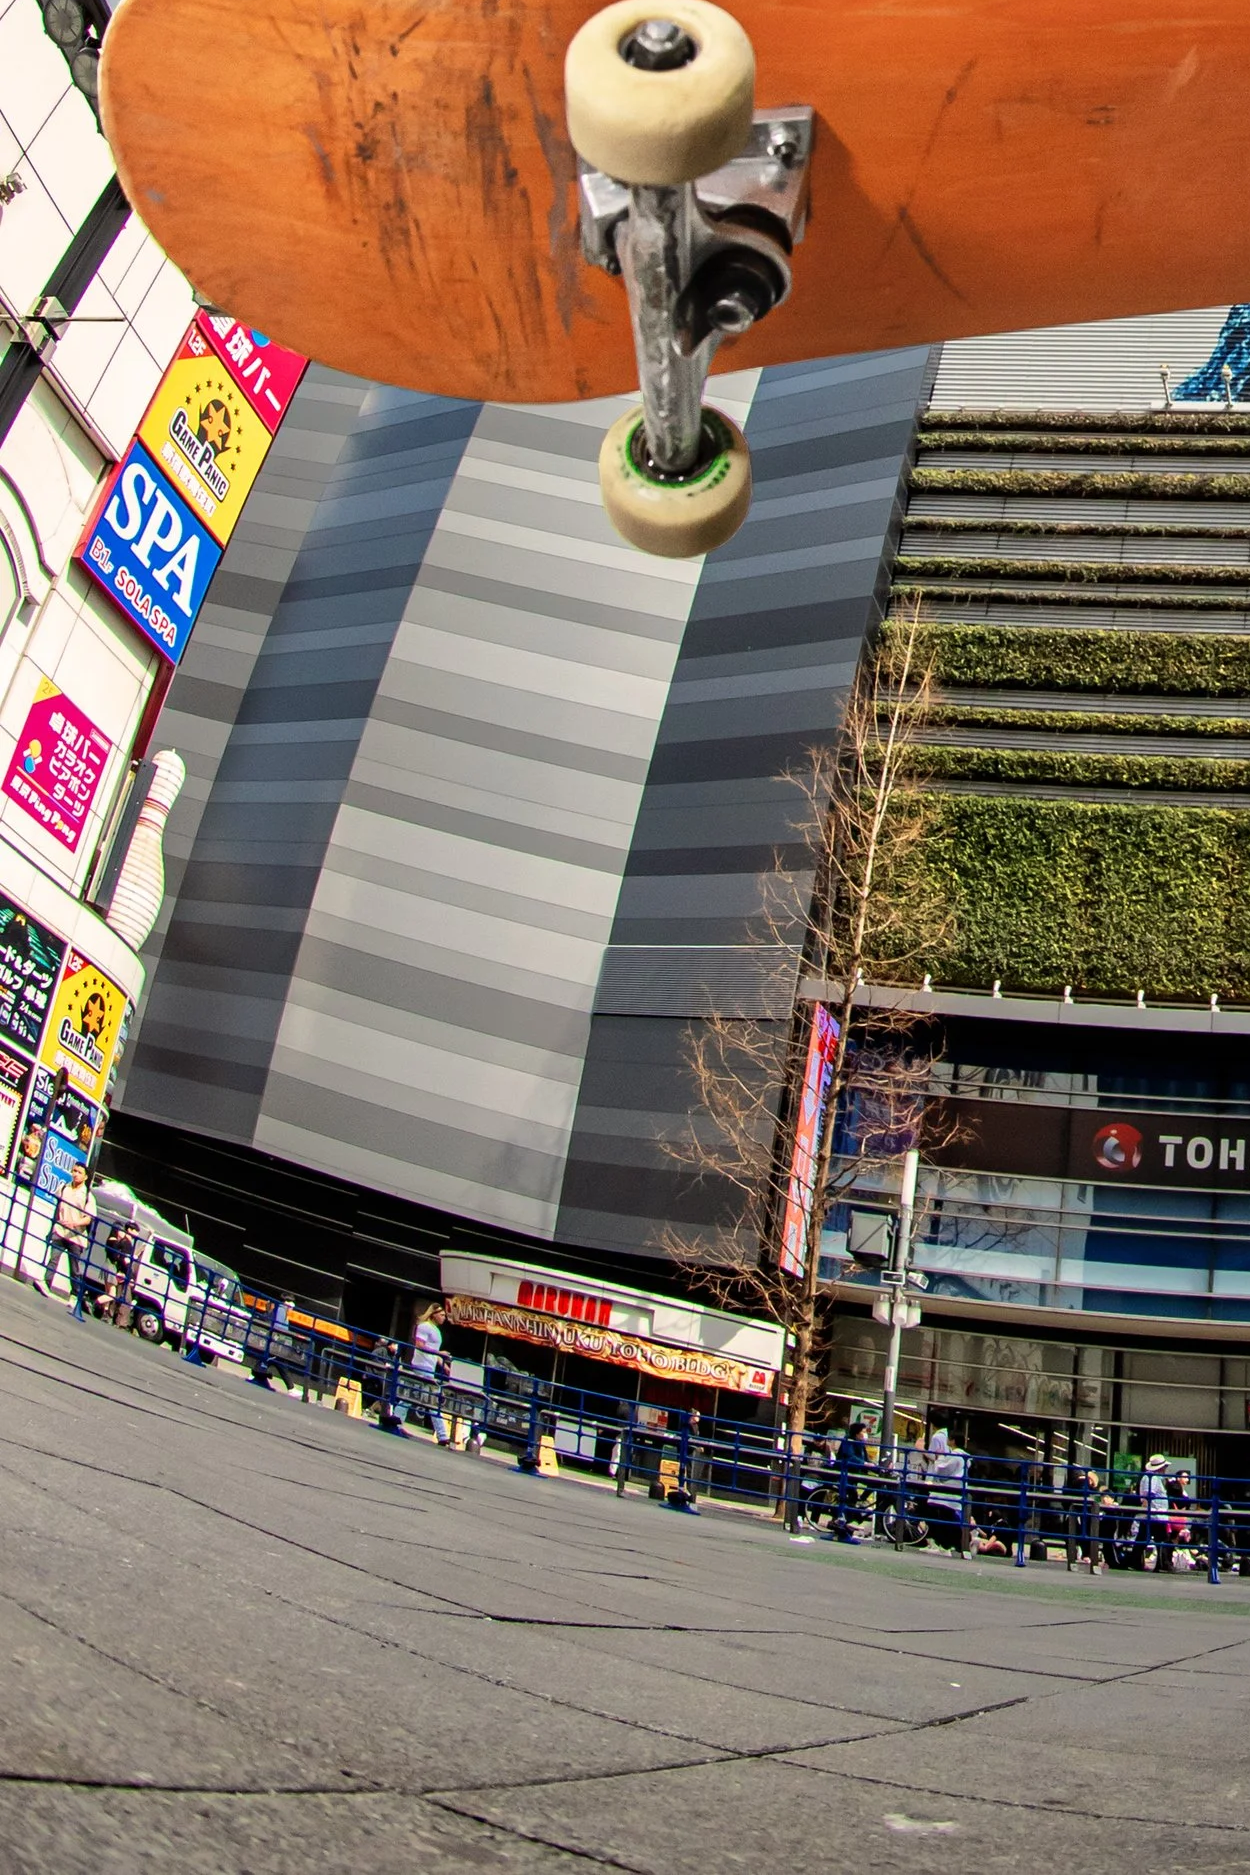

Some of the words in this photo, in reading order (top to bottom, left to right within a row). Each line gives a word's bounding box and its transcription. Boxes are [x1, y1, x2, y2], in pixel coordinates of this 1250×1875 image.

[171, 410, 200, 467] GAME
[198, 441, 228, 501] PANIC
[104, 463, 200, 617] SPA
[114, 567, 152, 620] SOLA
[149, 608, 178, 648] SPA
[49, 712, 100, 765] 卓球バー
[53, 784, 85, 817] ダーツ
[59, 1018, 84, 1053] GAME
[37, 1070, 65, 1106] Slep
